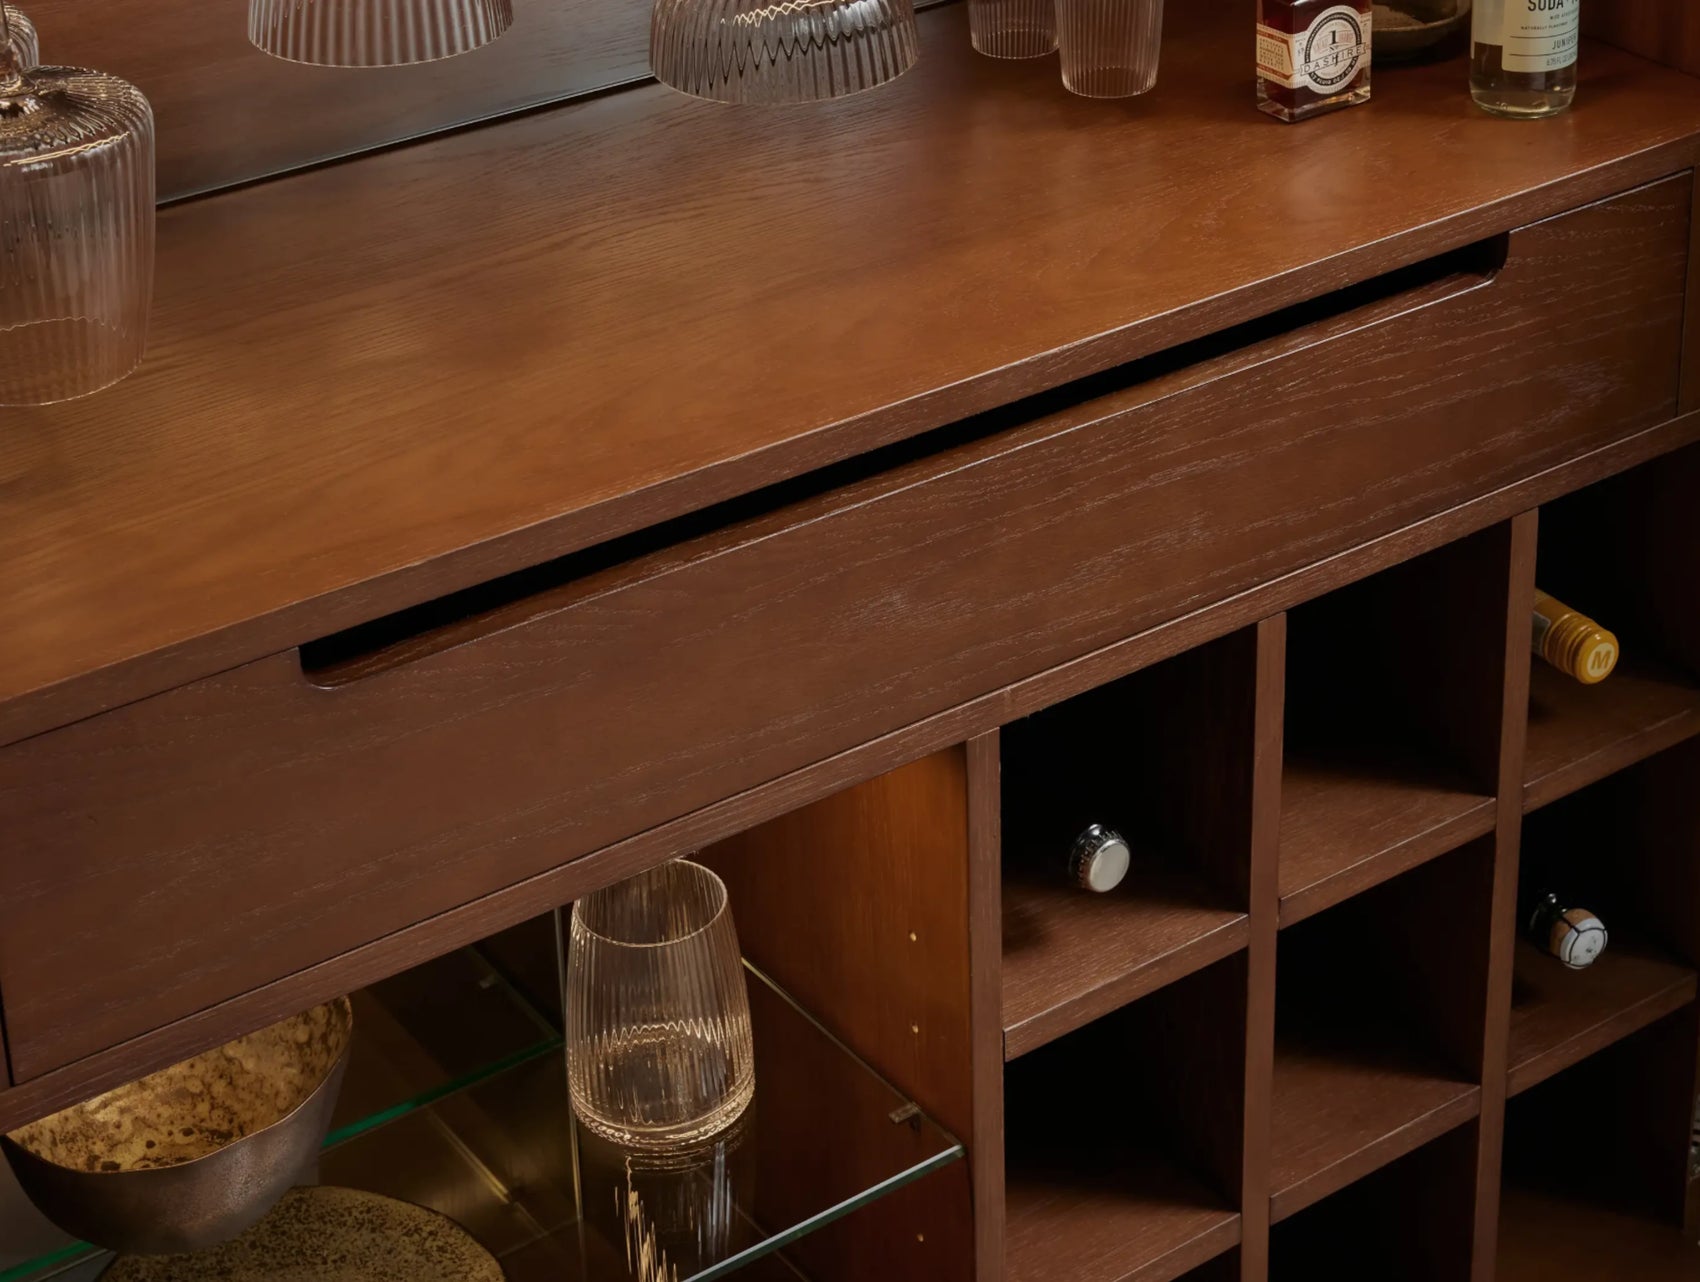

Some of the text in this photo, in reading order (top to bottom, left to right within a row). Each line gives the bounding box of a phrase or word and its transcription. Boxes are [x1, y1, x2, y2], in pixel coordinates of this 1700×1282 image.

[1528, 0, 1564, 11] SODA
[1329, 30, 1339, 45] 1
[1552, 32, 1577, 50] JUNIPER
[1591, 650, 1612, 670] M
